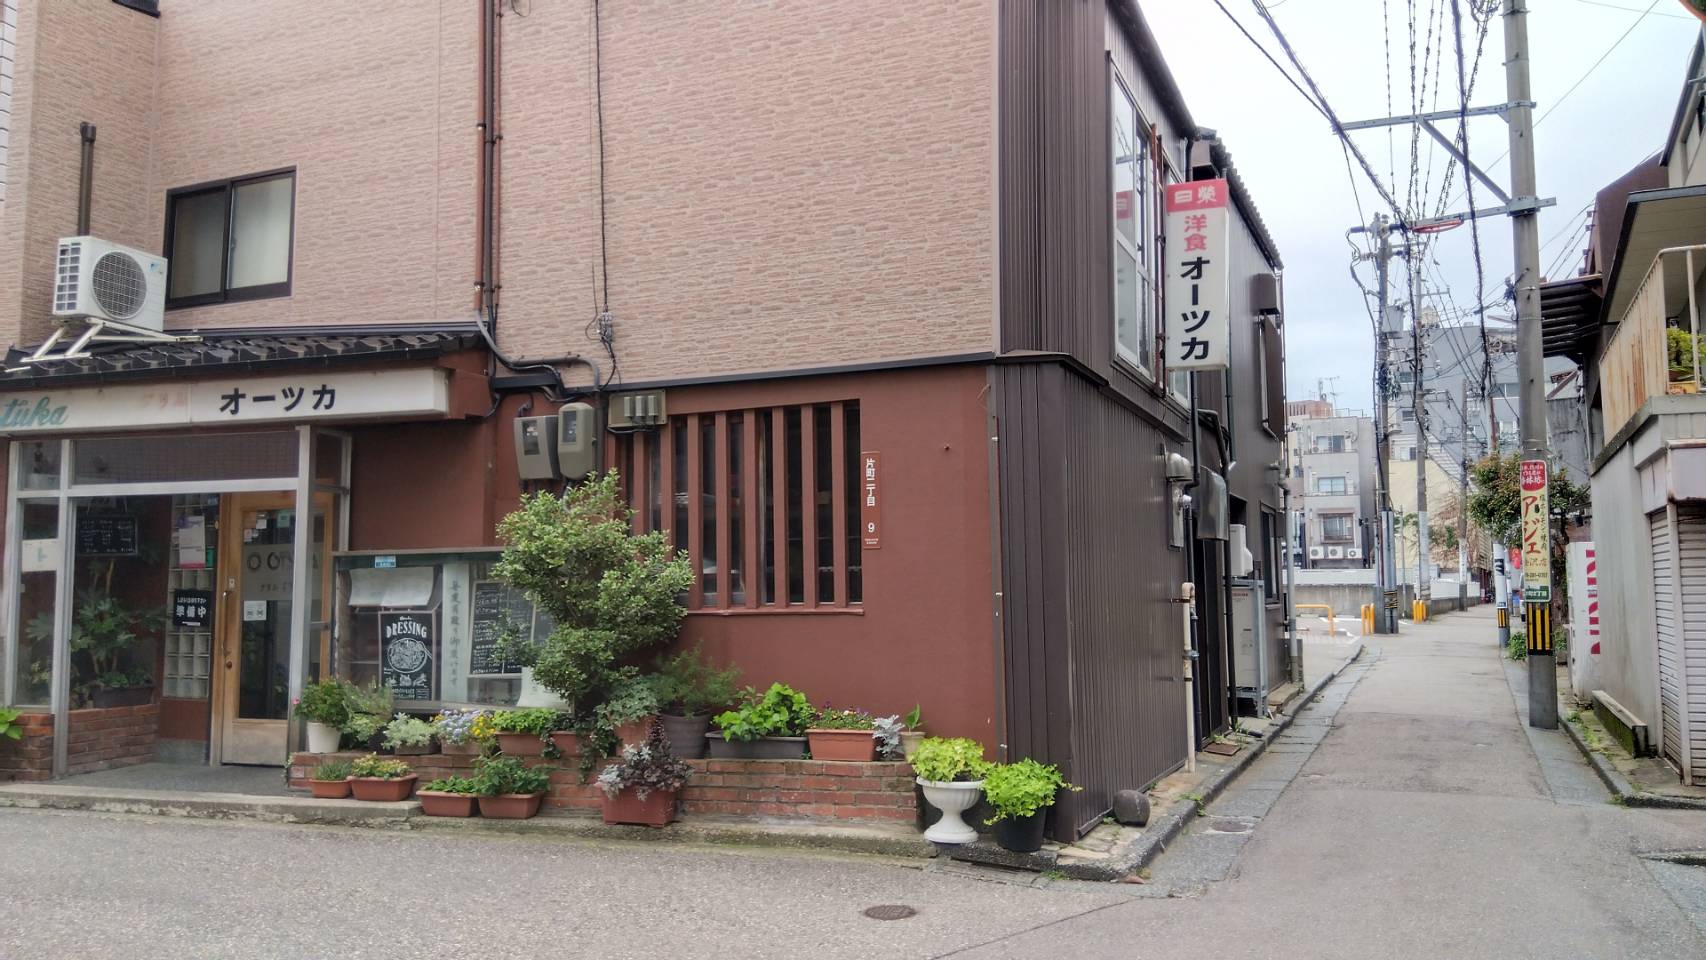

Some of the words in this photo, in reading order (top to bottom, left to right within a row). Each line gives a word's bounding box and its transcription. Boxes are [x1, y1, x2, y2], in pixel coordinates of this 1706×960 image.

[1184, 214, 1207, 251] 洋食
[1181, 256, 1210, 361] オーツカ
[219, 384, 336, 415] オーツカ
[865, 458, 876, 507] 片町二丁目
[867, 522, 875, 533] 9
[175, 604, 207, 618] 準備中
[386, 621, 428, 638] DRESSING
